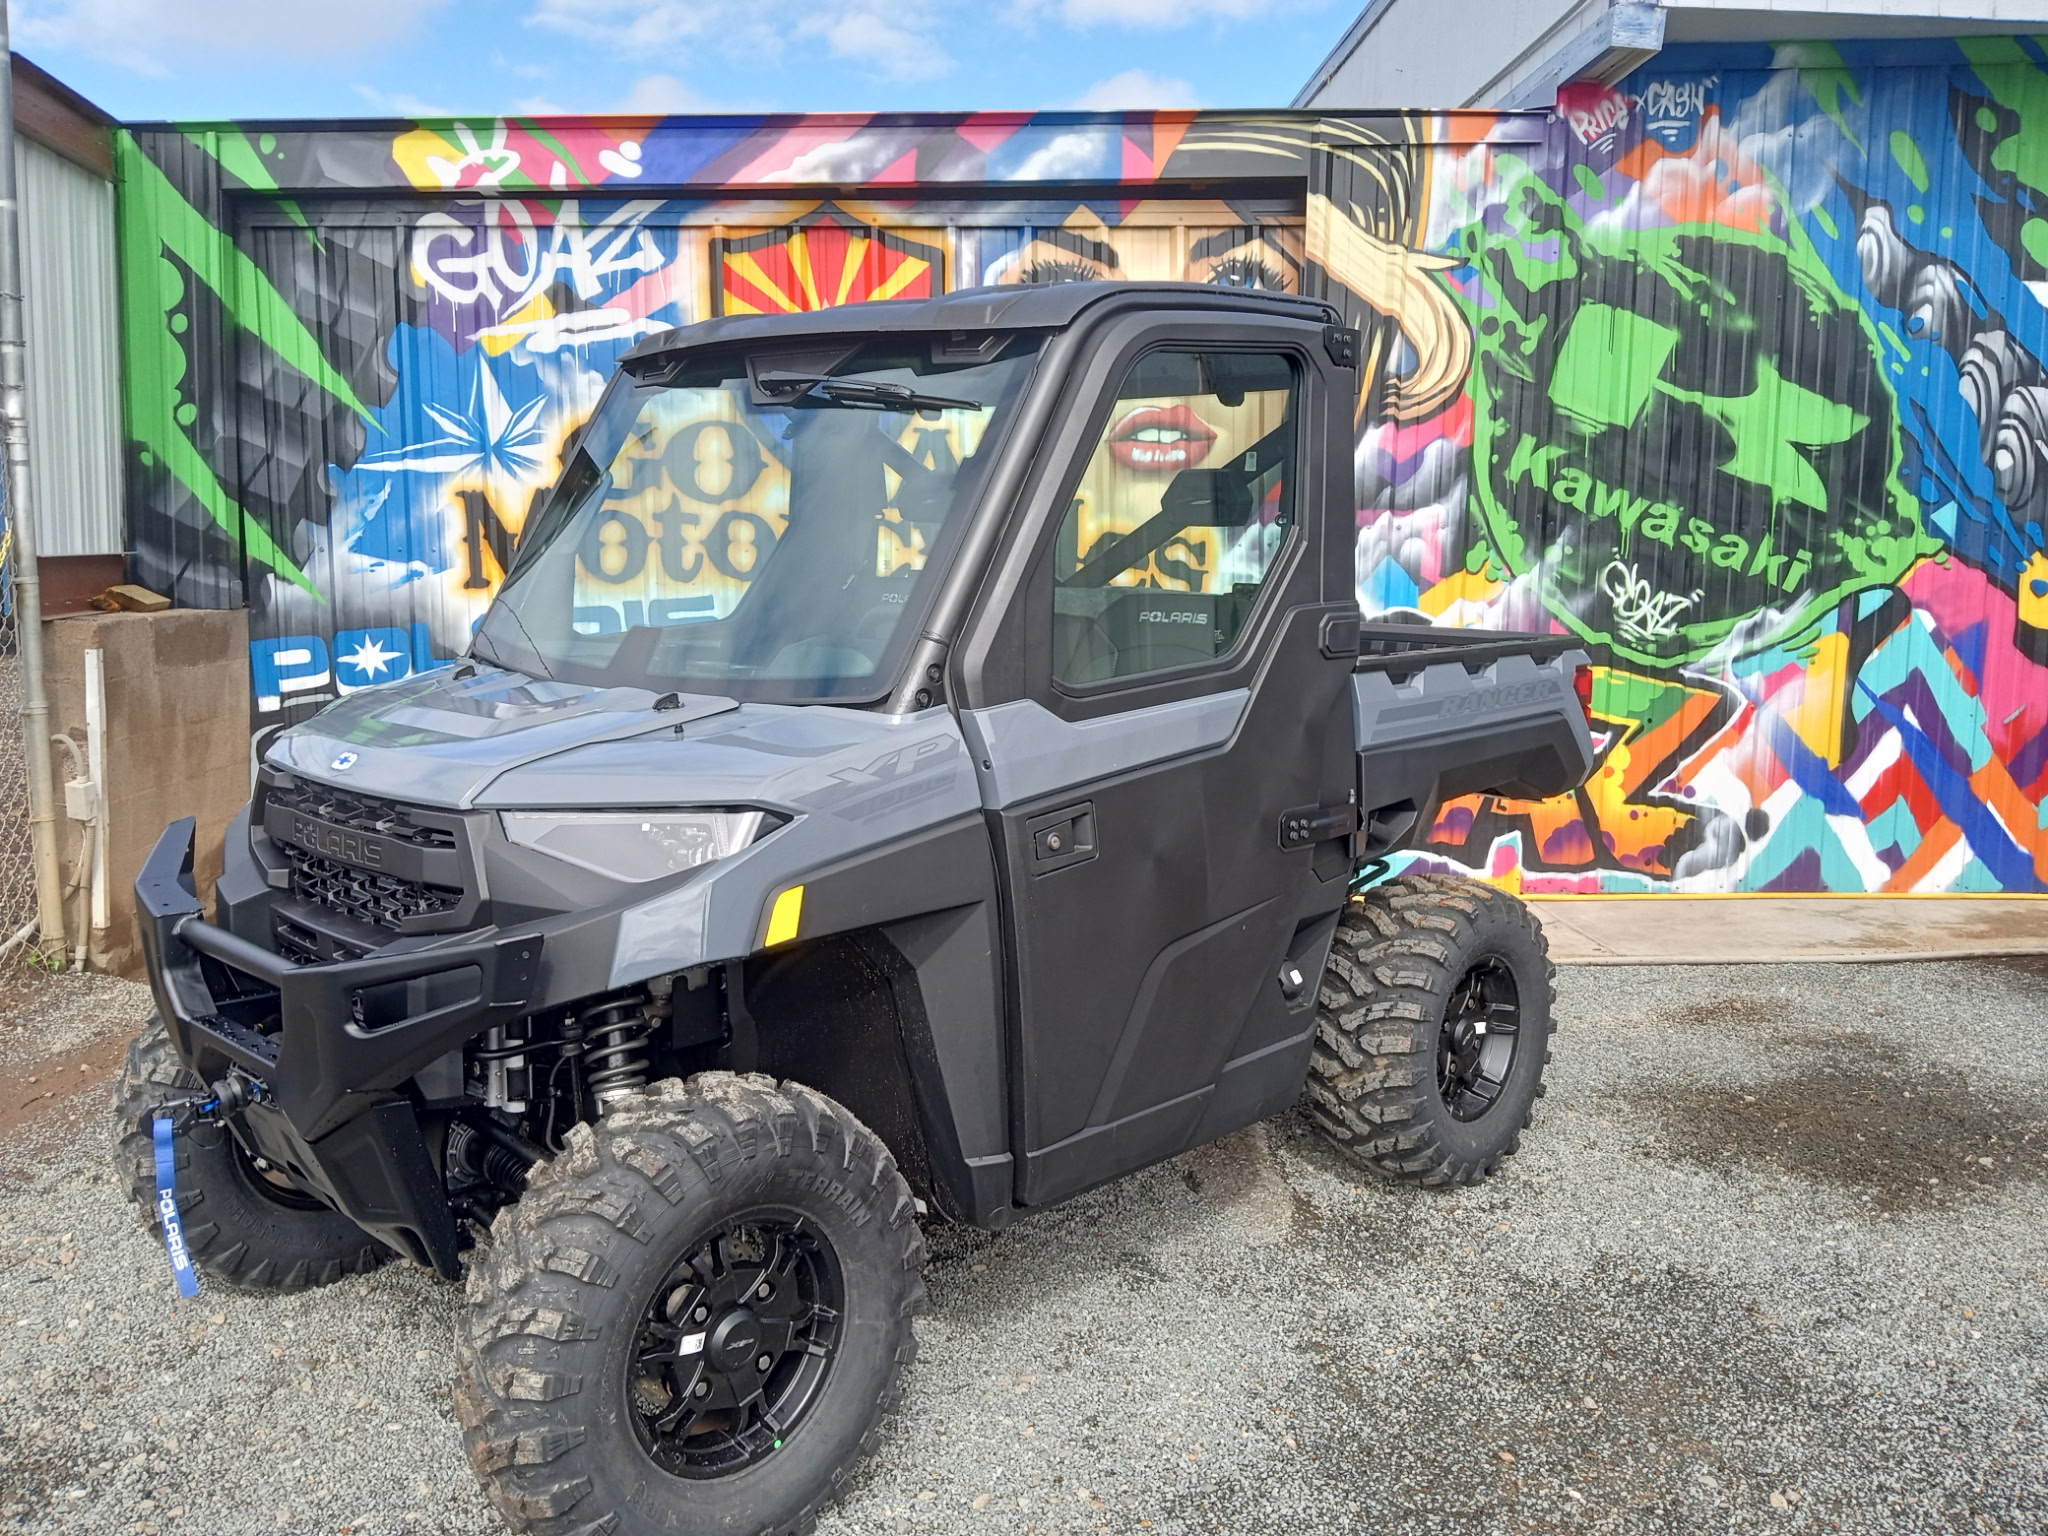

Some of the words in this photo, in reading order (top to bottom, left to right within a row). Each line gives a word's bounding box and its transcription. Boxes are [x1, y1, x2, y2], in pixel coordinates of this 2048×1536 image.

[1503, 432, 1813, 593] Kawasaki
[1138, 610, 1209, 625] POLARIS
[1438, 679, 1554, 718] RANGER
[826, 732, 960, 787] XP
[291, 816, 383, 868] POLARIS
[158, 1187, 189, 1272] POLARIS
